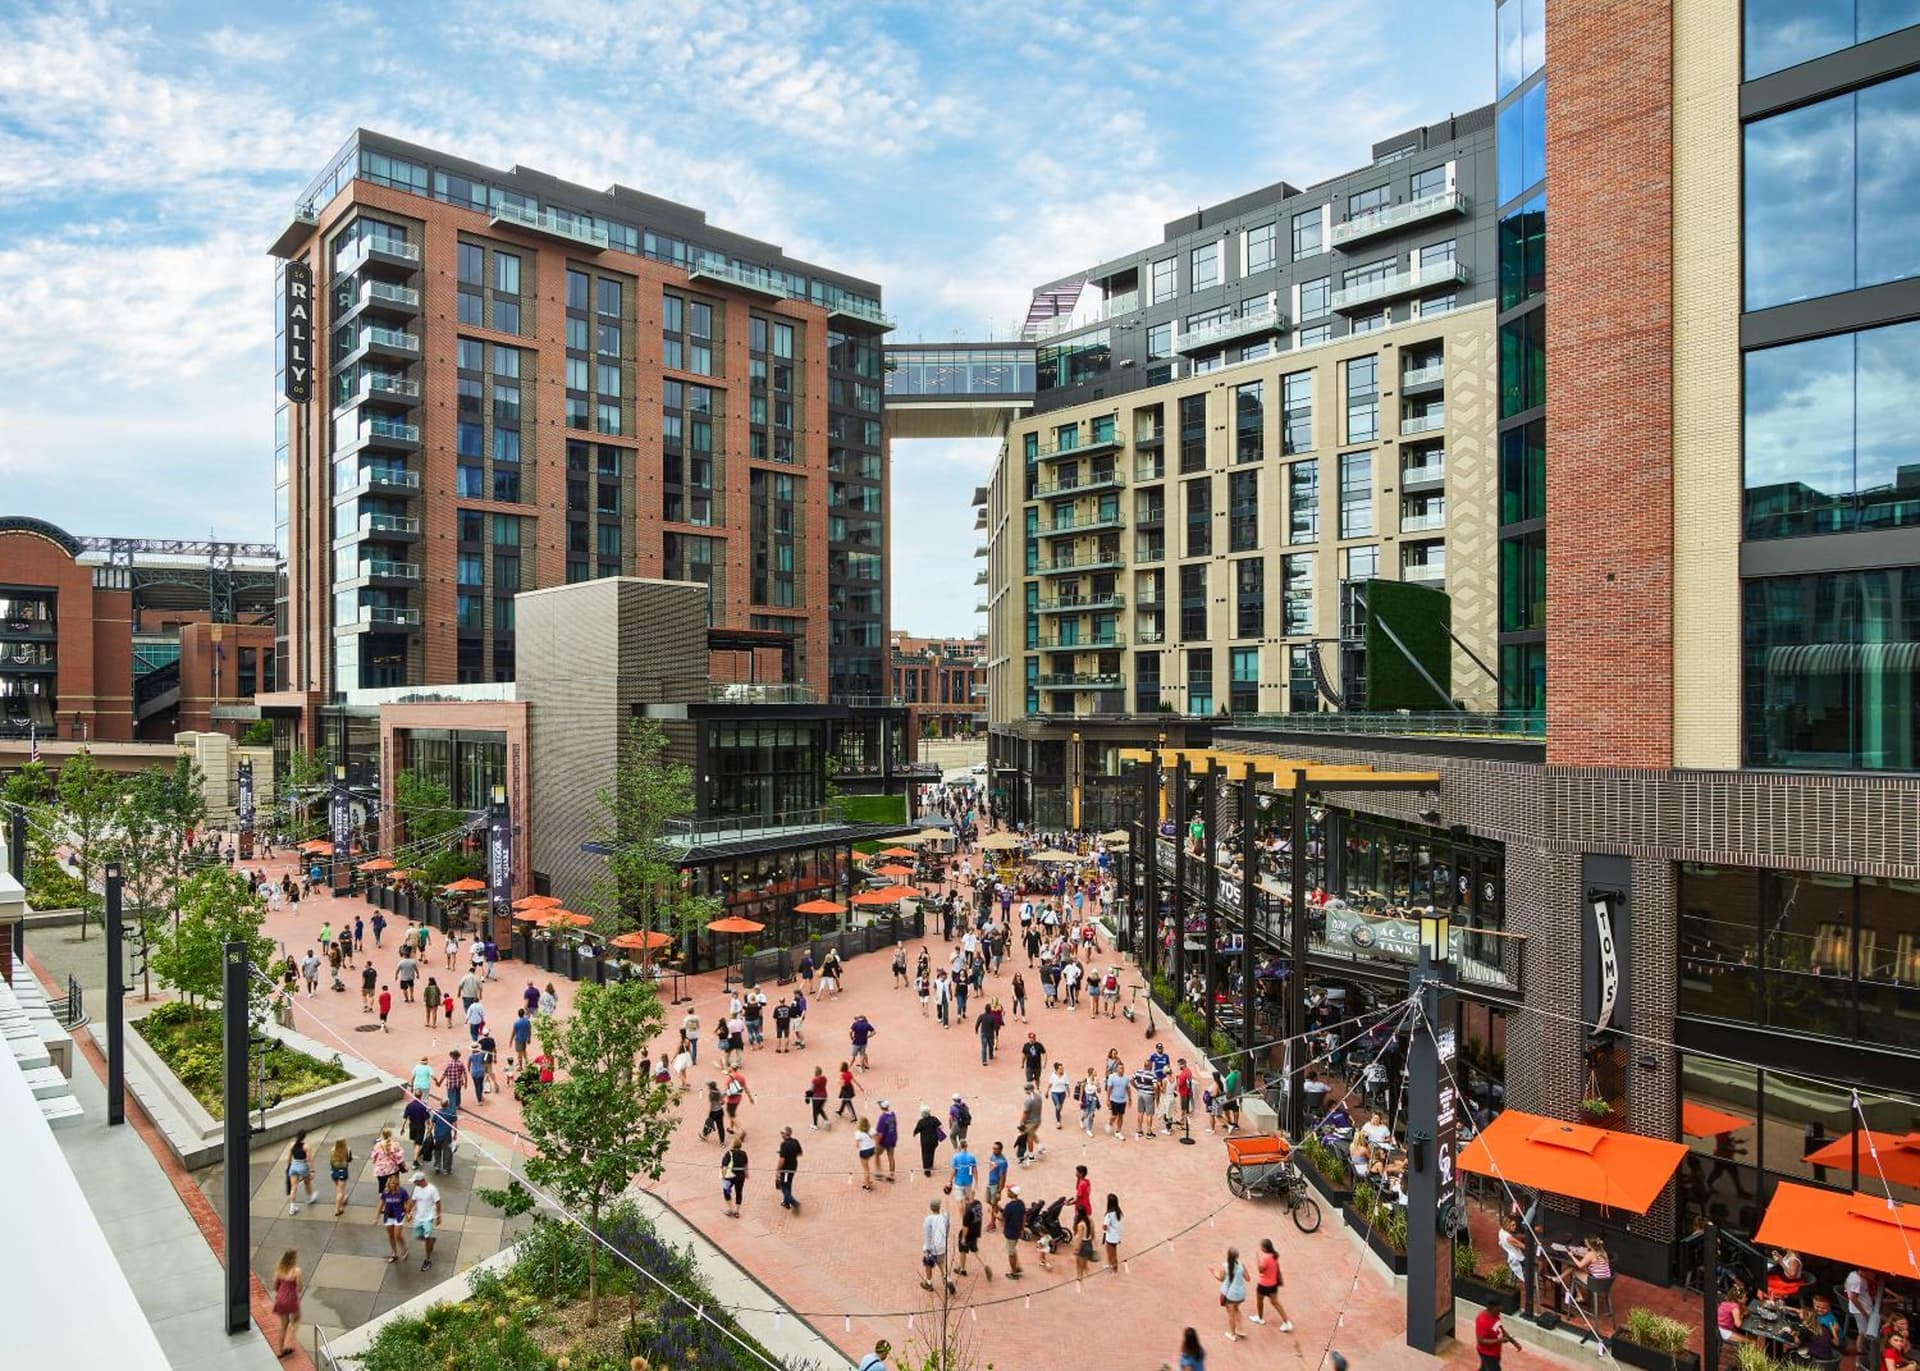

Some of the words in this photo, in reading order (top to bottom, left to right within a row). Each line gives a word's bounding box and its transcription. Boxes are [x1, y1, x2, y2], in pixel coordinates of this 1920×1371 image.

[290, 282, 308, 382] RALLY
[1378, 942, 1413, 955] TANK
[1599, 912, 1617, 1002] TOM'S
